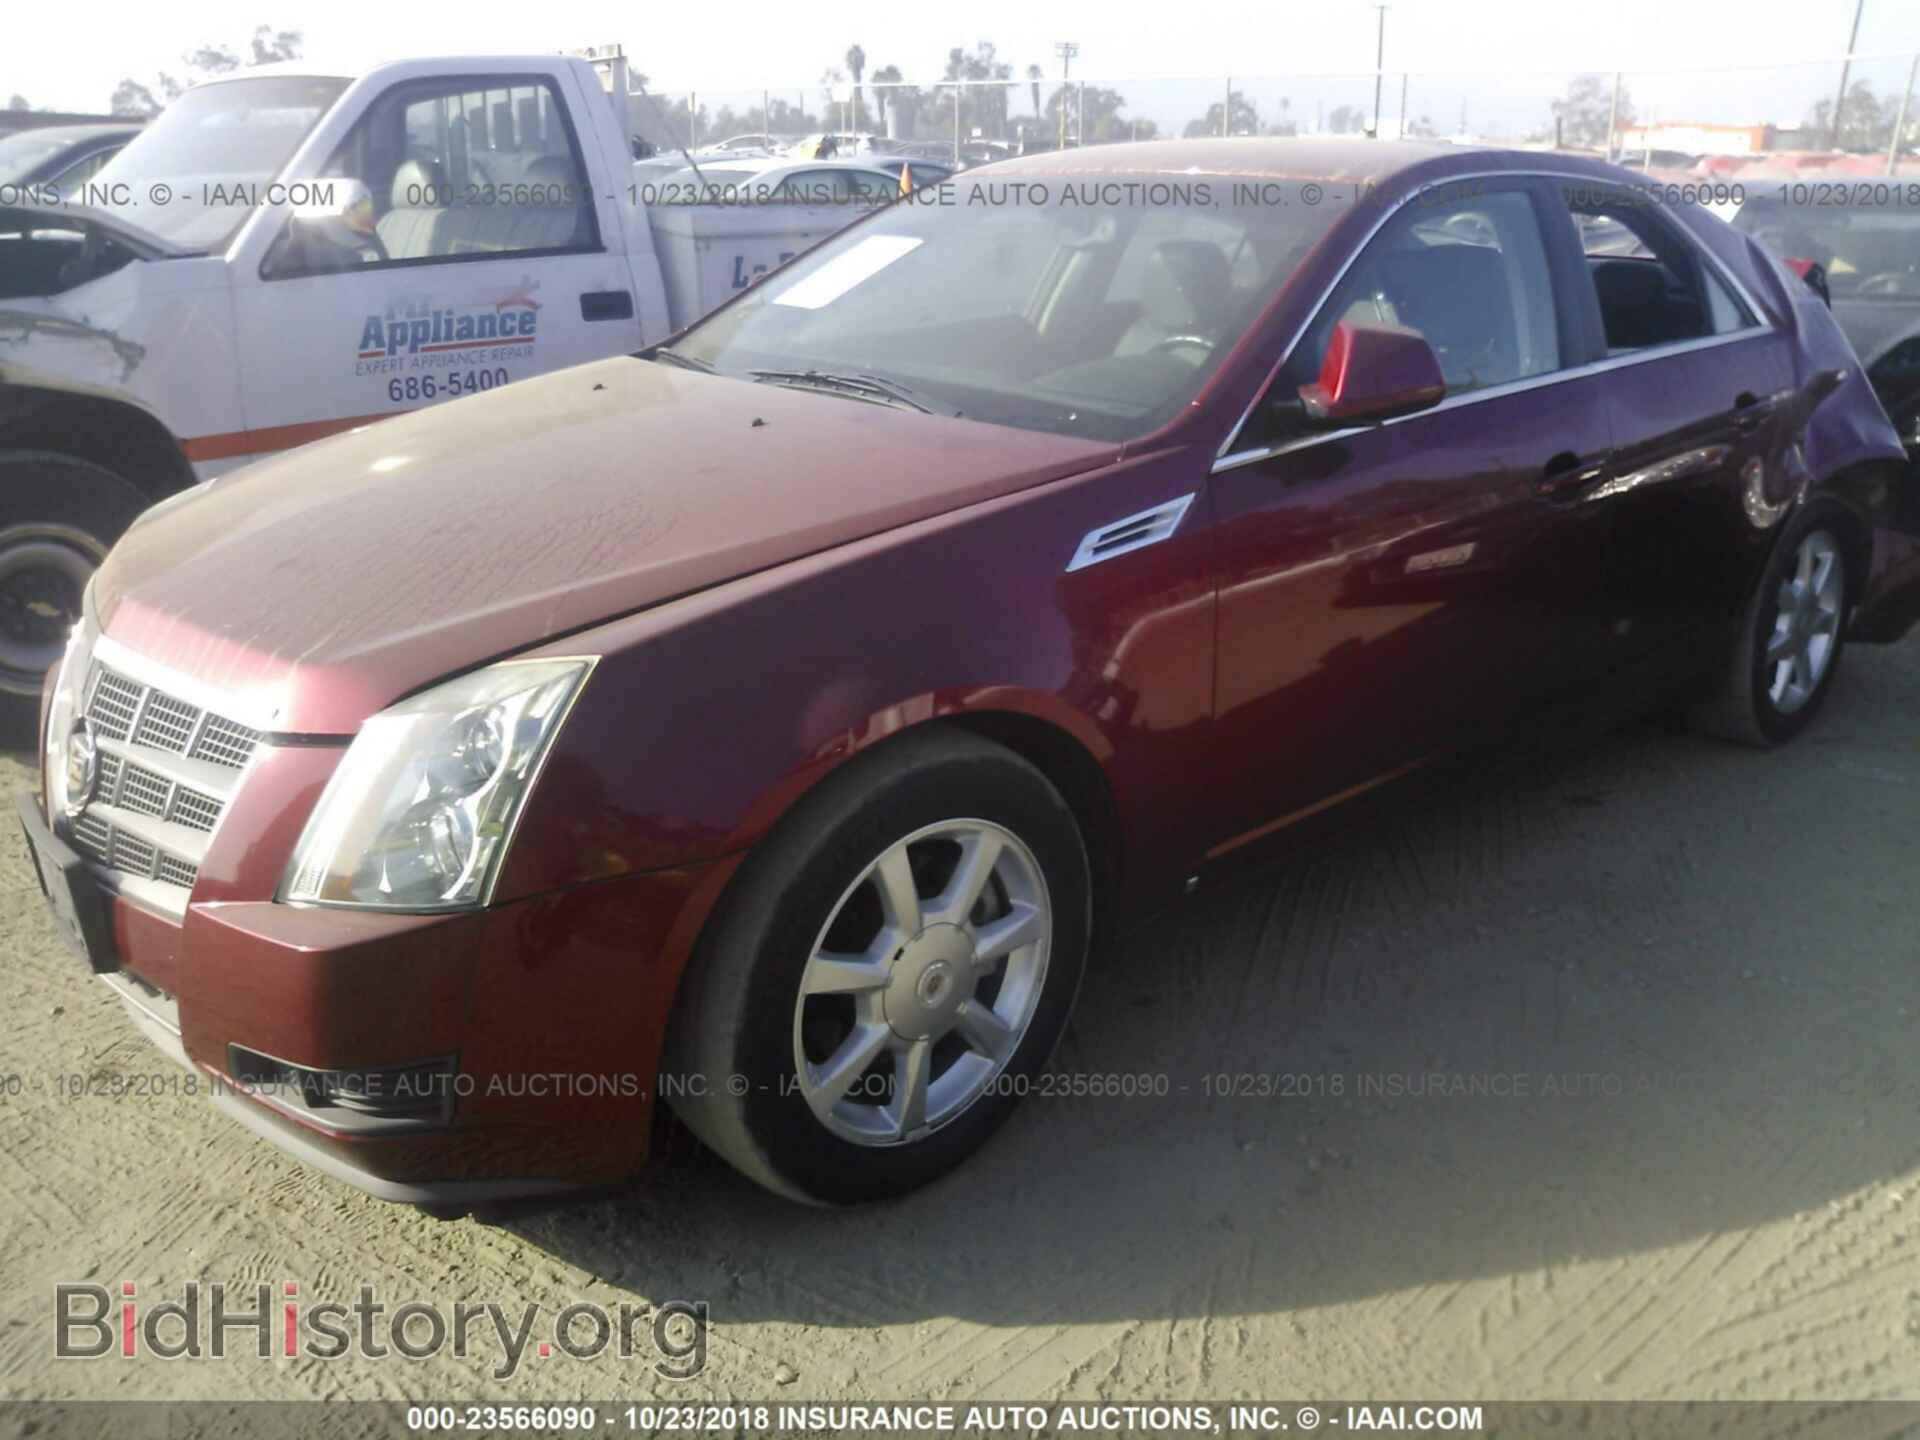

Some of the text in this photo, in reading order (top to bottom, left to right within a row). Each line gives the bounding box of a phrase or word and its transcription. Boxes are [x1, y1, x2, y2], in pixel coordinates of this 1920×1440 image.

[359, 309, 537, 355] Appliance
[355, 357, 406, 376] EXPERT
[411, 350, 489, 369] APPLIANCE
[388, 367, 509, 402] 686-5400
